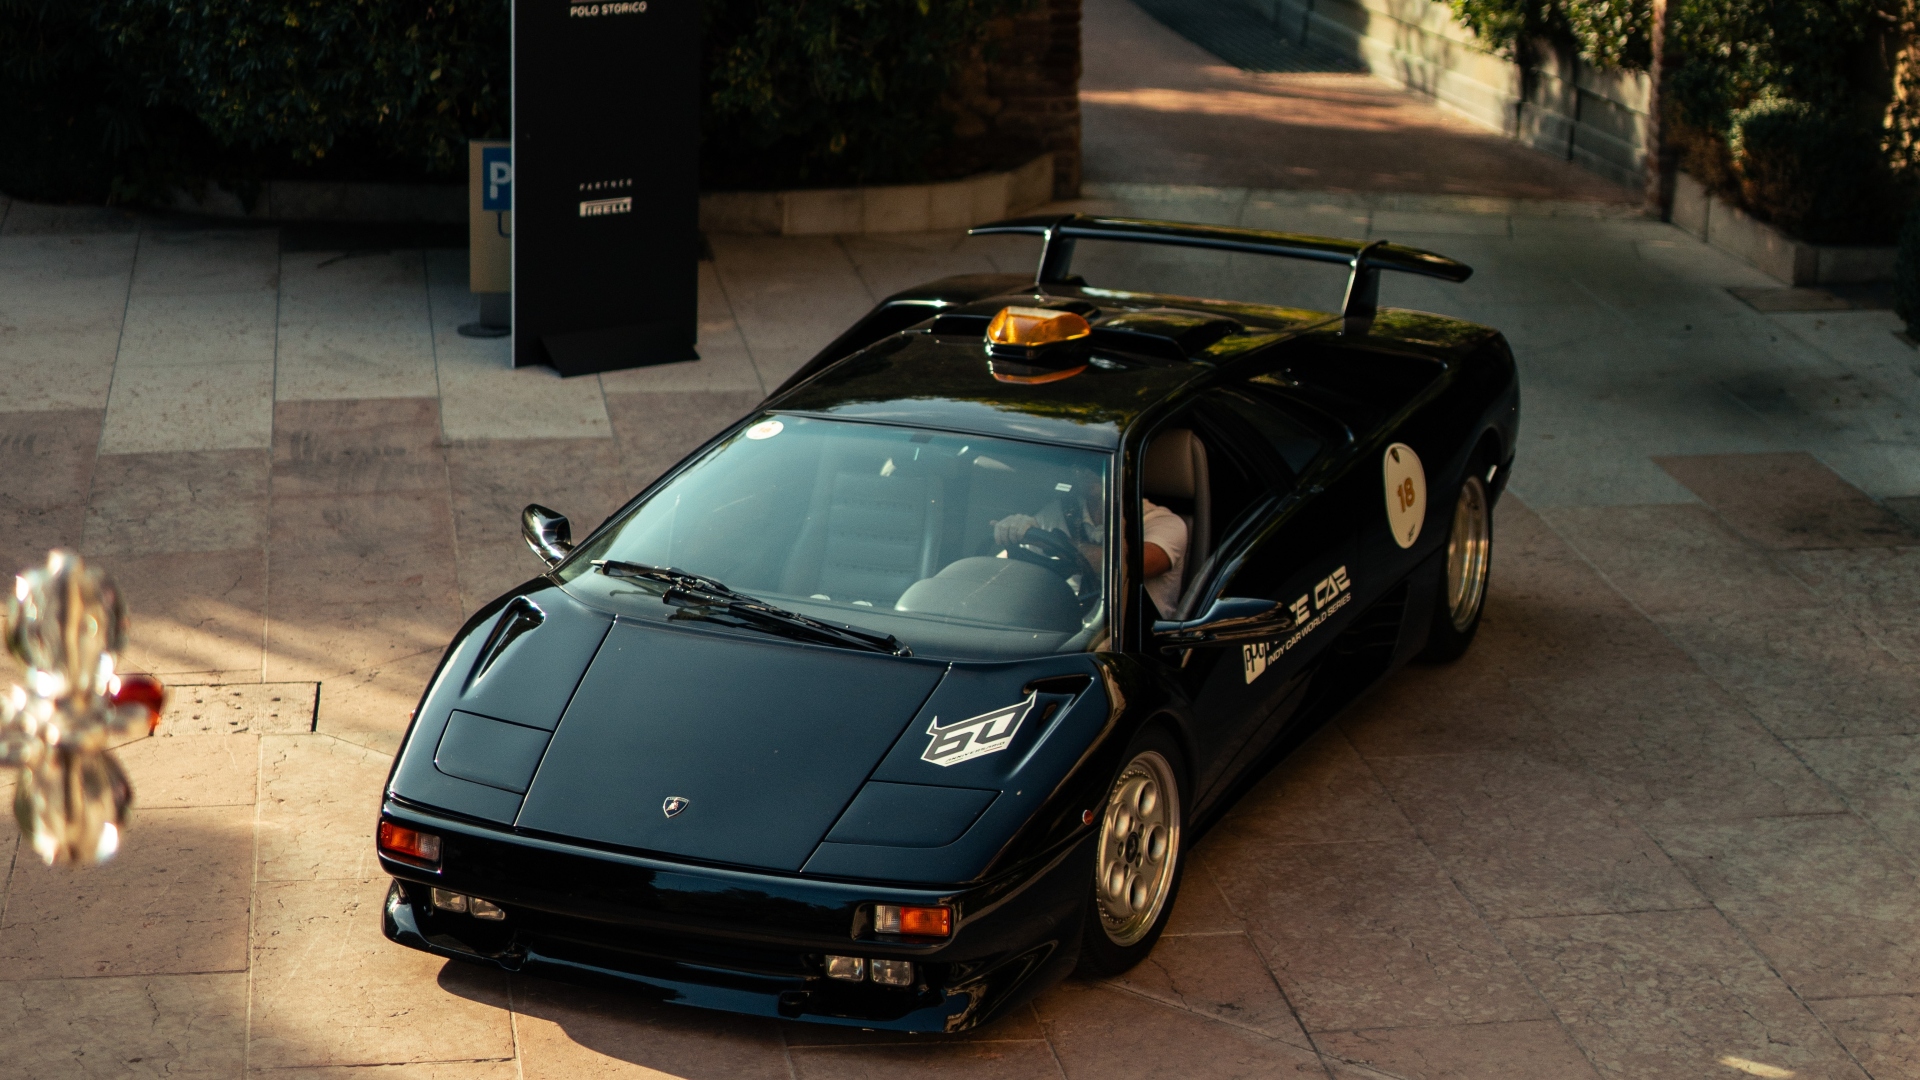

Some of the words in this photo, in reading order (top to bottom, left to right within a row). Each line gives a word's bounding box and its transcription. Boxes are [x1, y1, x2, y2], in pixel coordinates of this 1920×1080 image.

[570, 4, 600, 18] POLO
[601, 1, 648, 16] STORICO
[489, 161, 512, 199] P
[579, 178, 633, 191] PARTNER
[579, 197, 633, 218] PIRELLI
[1397, 477, 1416, 513] 18
[1267, 644, 1286, 666] INDY
[1285, 631, 1302, 651] CAR
[1301, 611, 1328, 638] WORLD
[1326, 592, 1352, 617] SERIES
